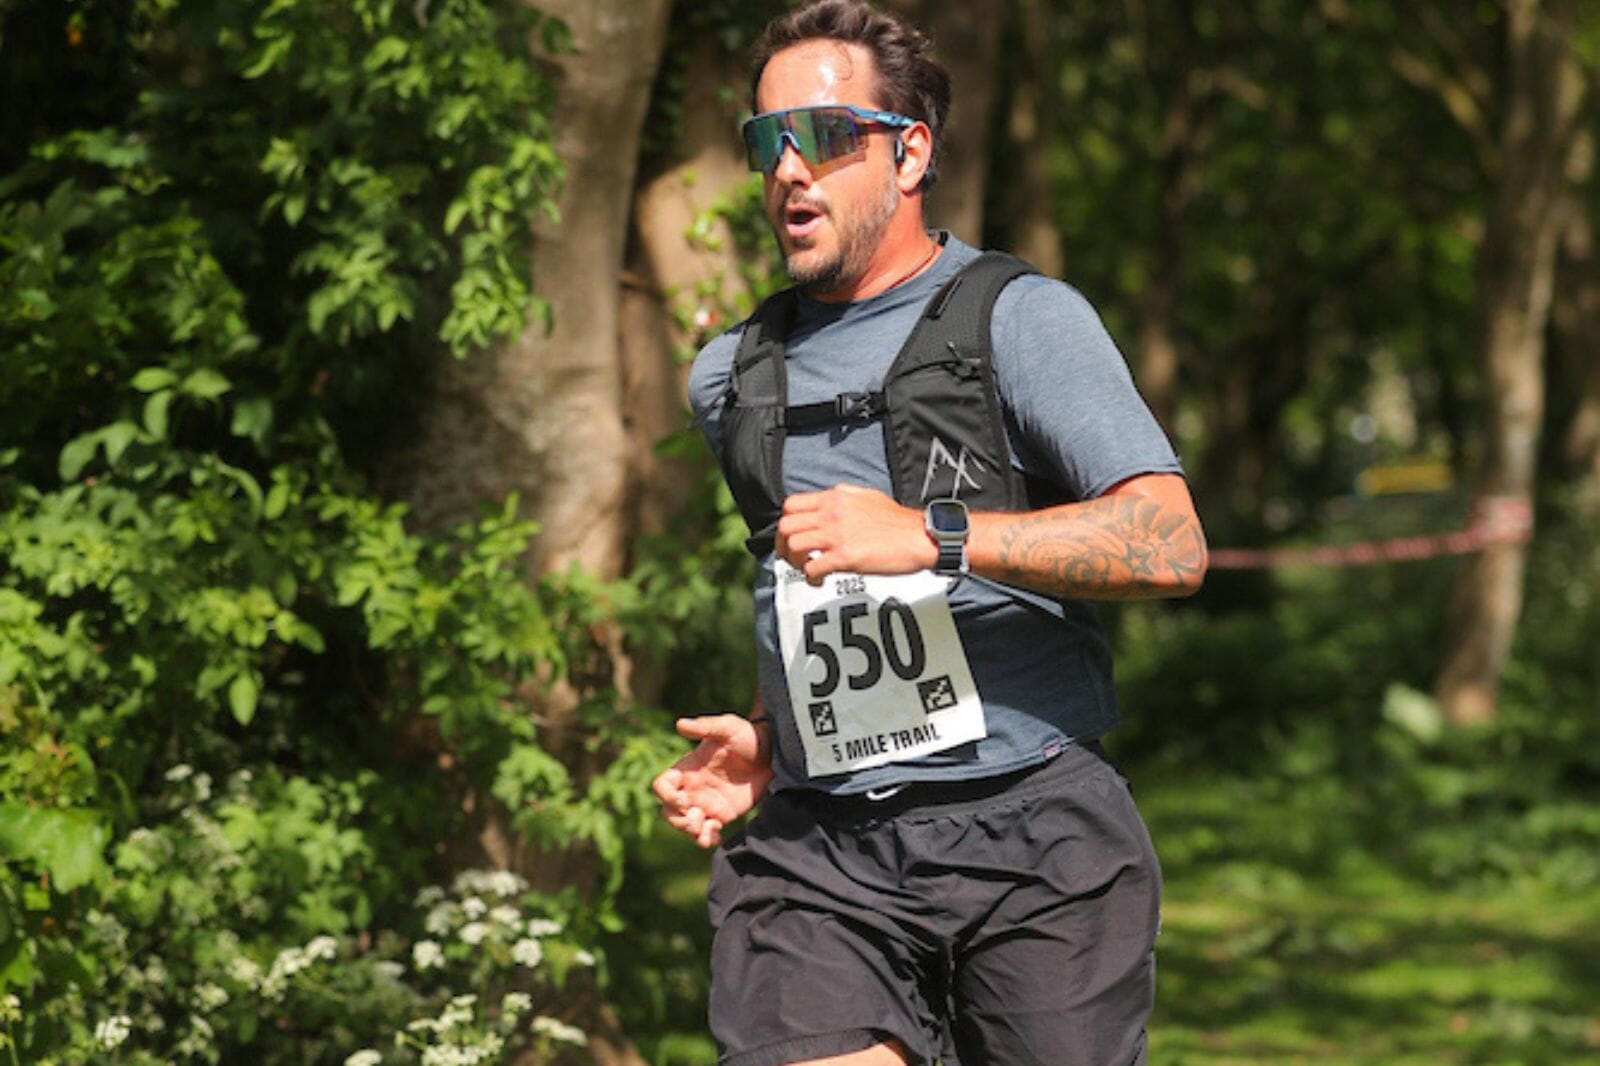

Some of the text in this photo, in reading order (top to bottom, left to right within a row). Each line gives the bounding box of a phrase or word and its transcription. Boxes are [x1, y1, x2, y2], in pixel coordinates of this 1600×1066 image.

[835, 575, 866, 596] 2025
[803, 596, 927, 698] 550
[831, 722, 942, 763] 5 MILE TRAIL
